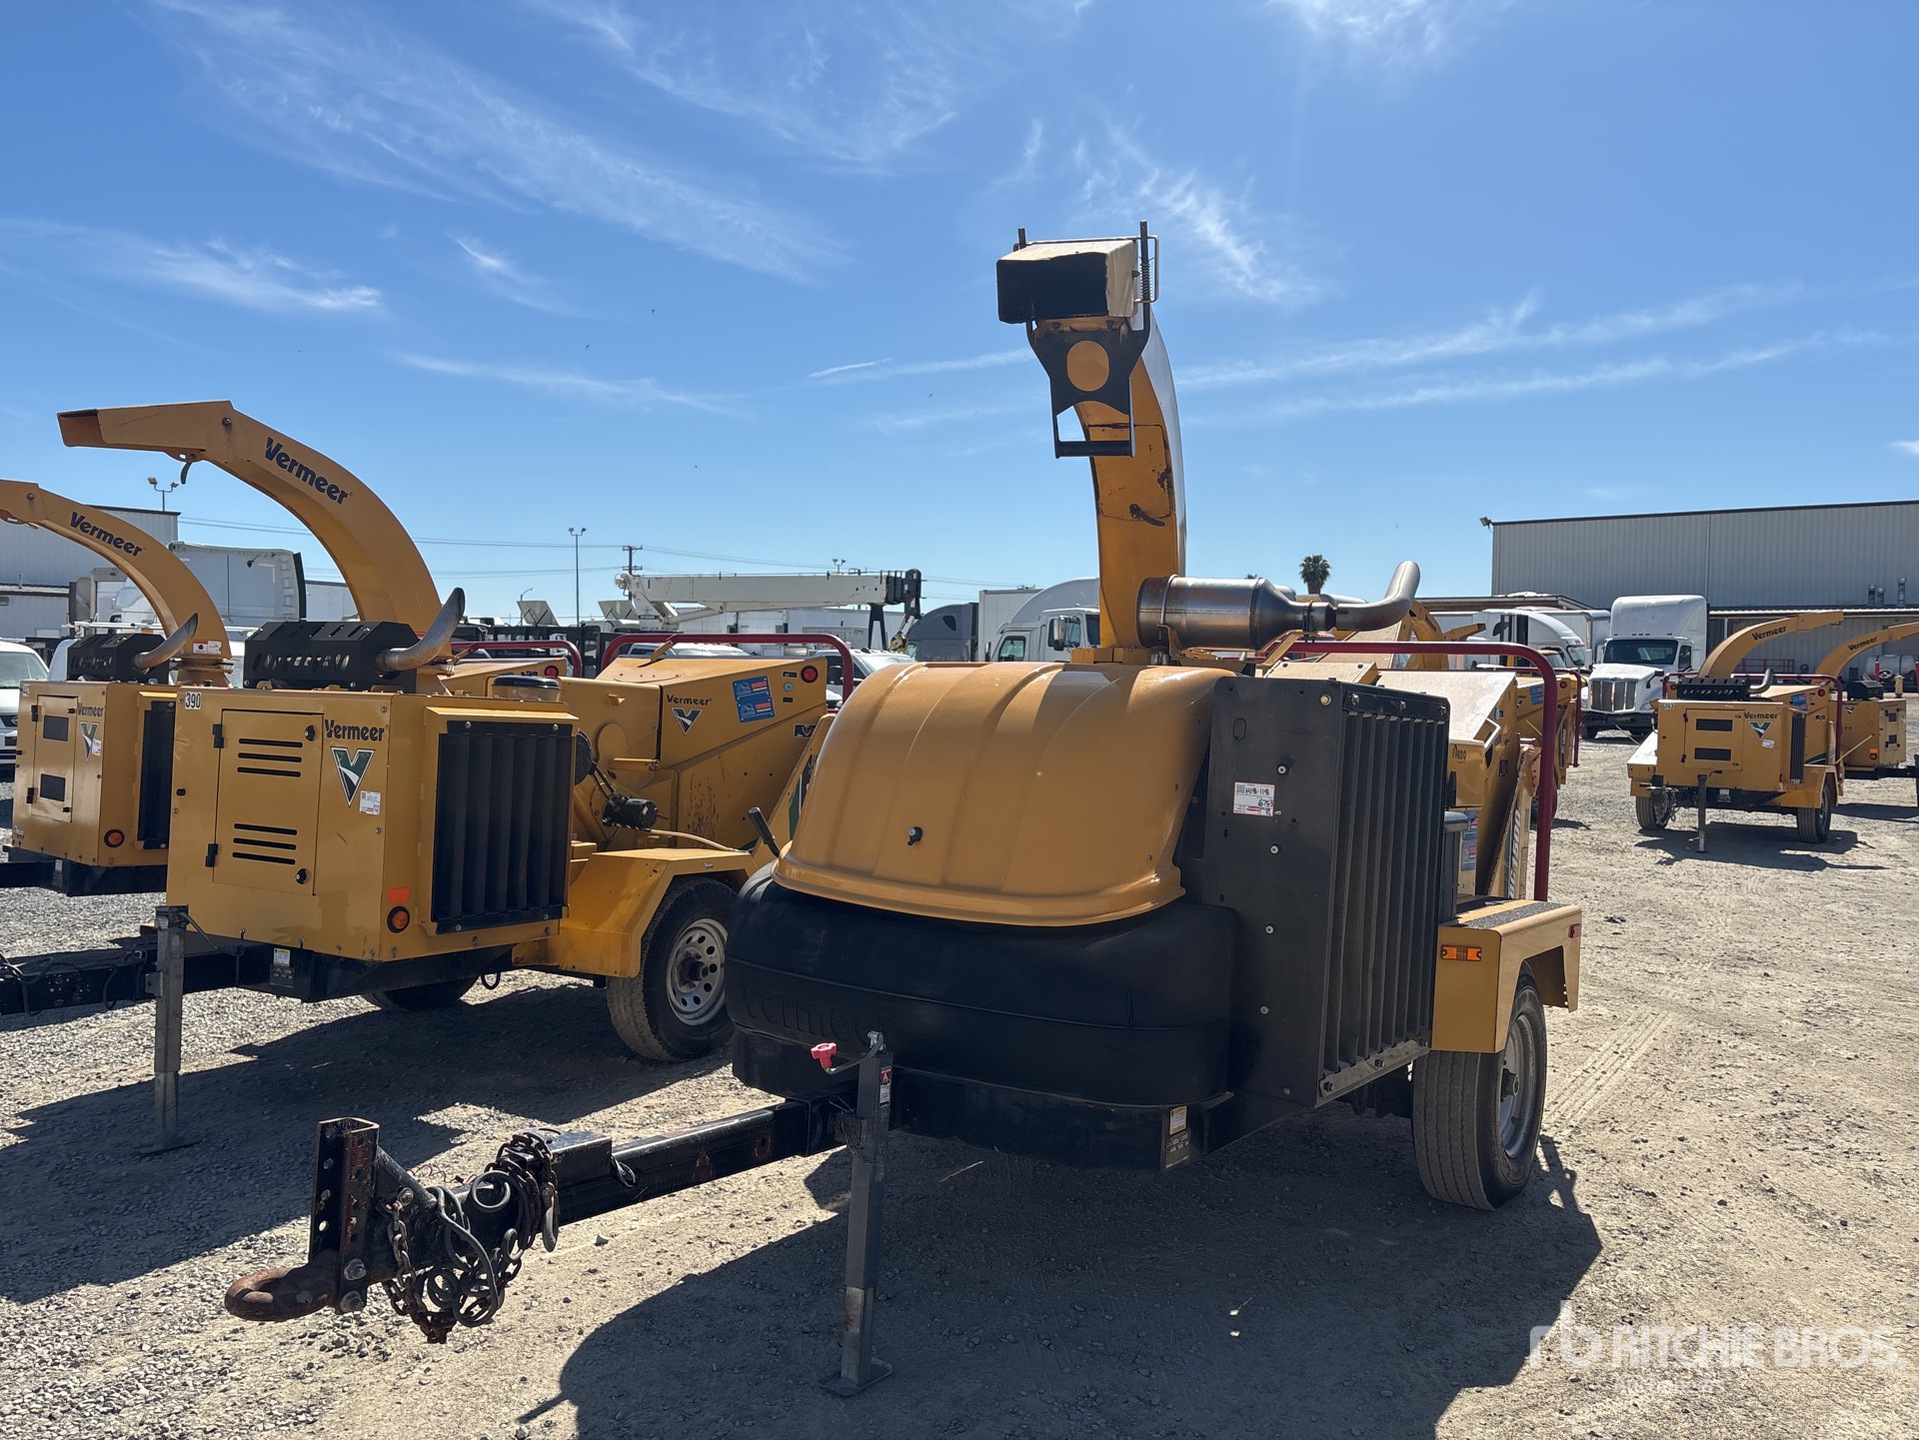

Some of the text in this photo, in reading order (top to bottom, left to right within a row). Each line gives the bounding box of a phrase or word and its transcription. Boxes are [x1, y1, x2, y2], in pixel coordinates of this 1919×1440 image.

[265, 436, 349, 505] Vermeer
[70, 511, 143, 557] Vermeer
[1752, 625, 1787, 641] Vermeer
[1847, 636, 1878, 651] Vermeer
[185, 692, 201, 708] 390
[666, 694, 711, 706] Vermeer
[77, 702, 104, 717] Vermeer
[1744, 712, 1779, 720] Vermeer
[324, 719, 385, 742] Vermeer
